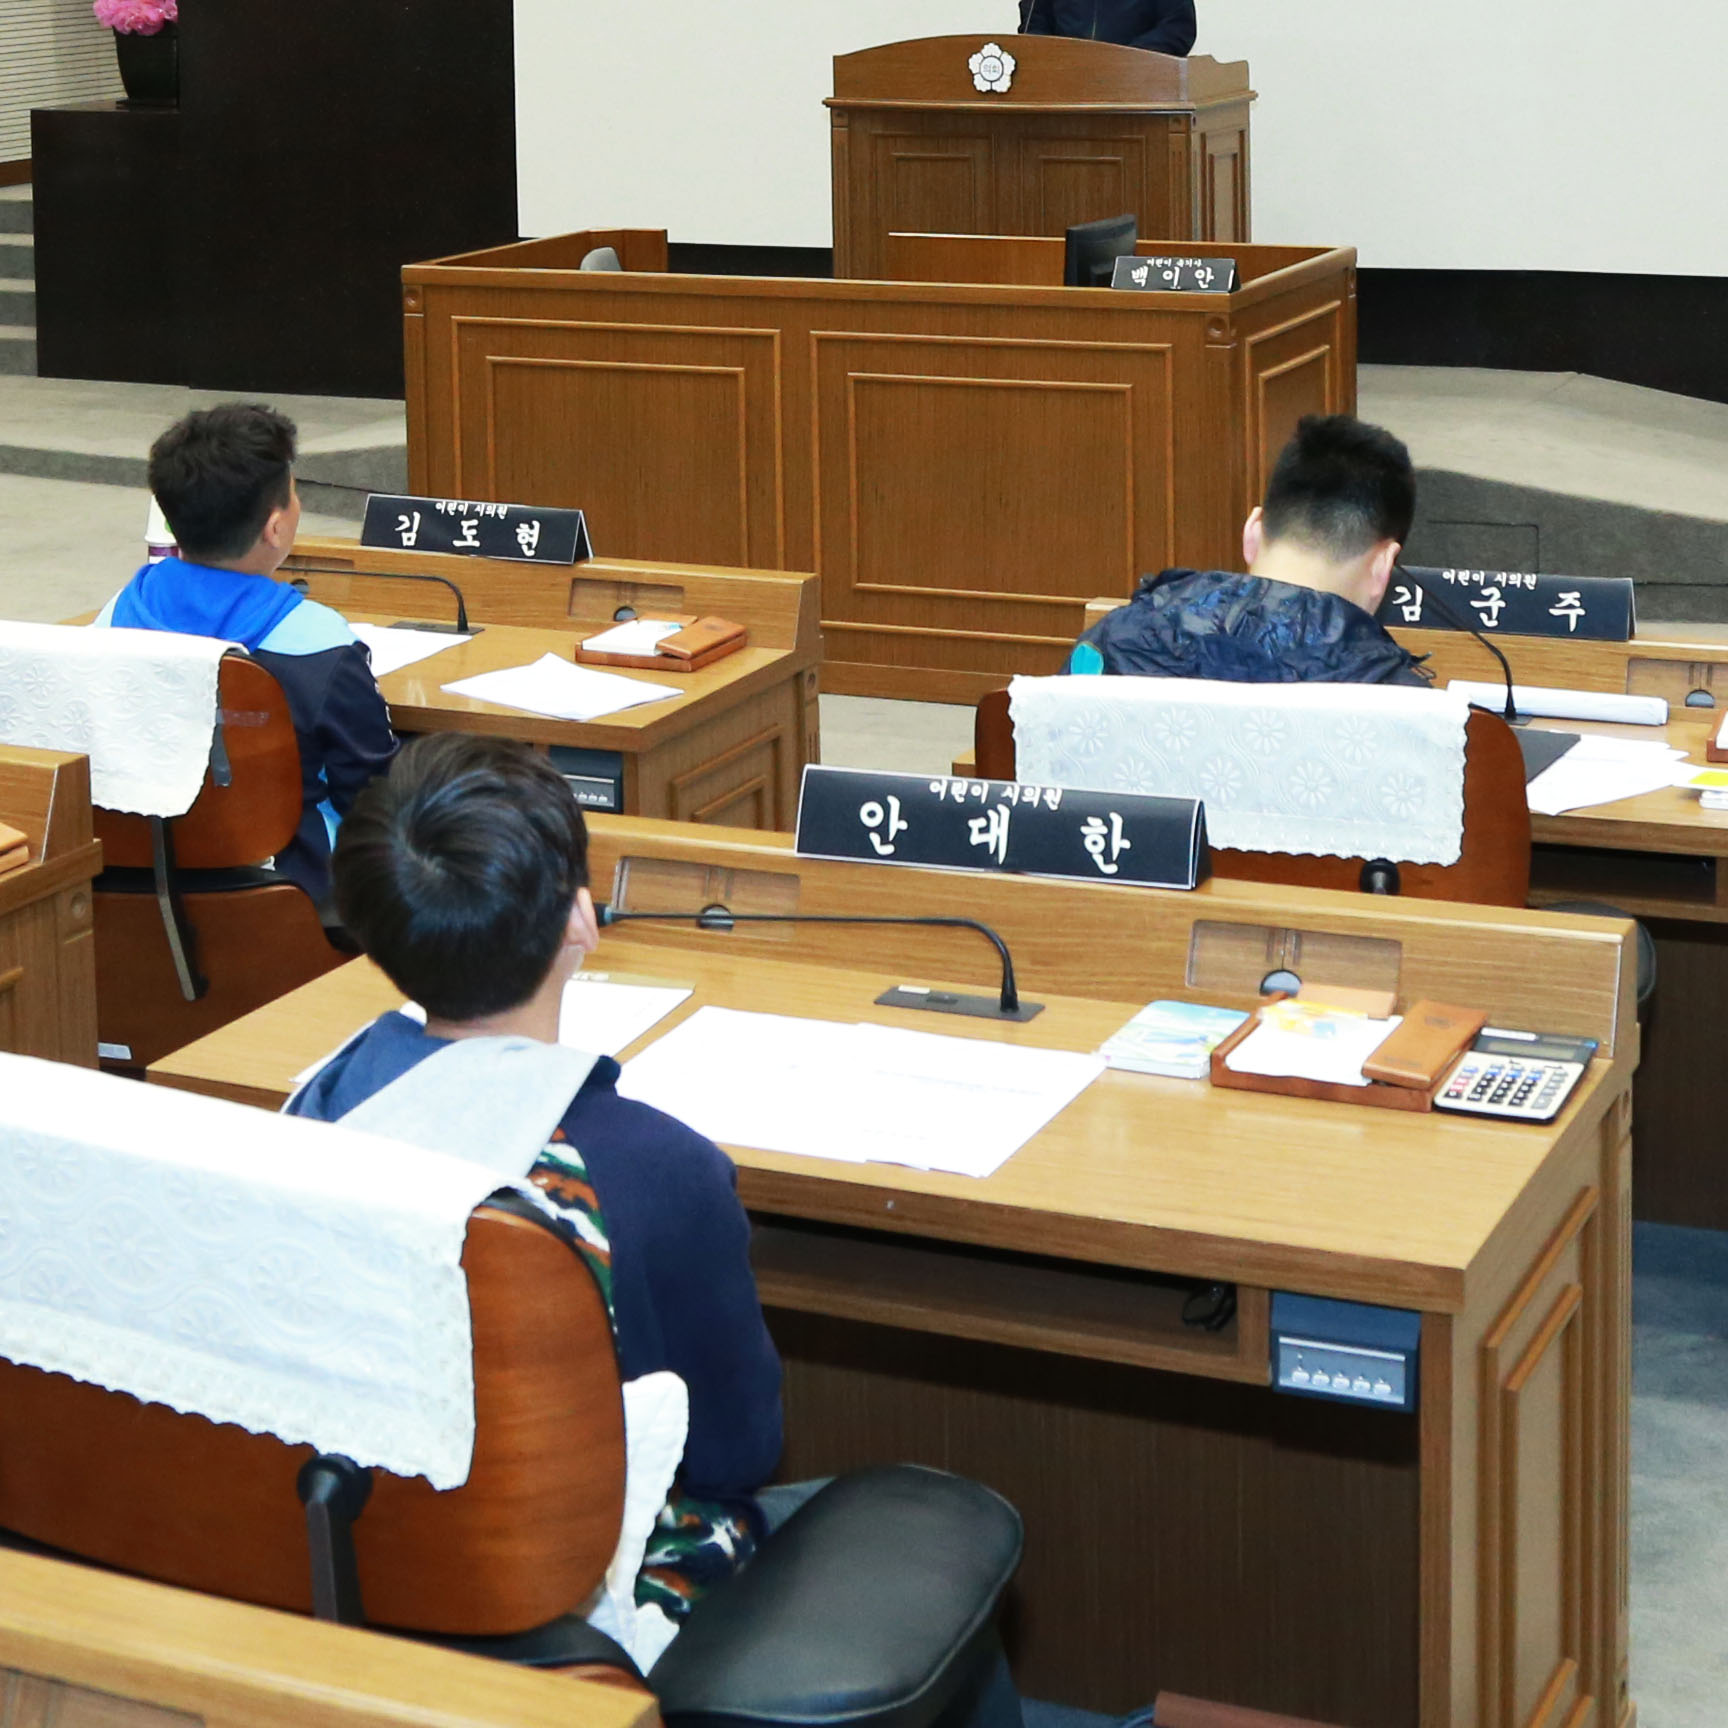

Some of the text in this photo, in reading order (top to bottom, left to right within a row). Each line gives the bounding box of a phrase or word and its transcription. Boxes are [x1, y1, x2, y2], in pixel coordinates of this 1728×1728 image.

[434, 501, 509, 520] 어린이 시의원
[1442, 569, 1538, 590] 어린이 시의원
[928, 778, 1064, 812] 어린이 시의원
